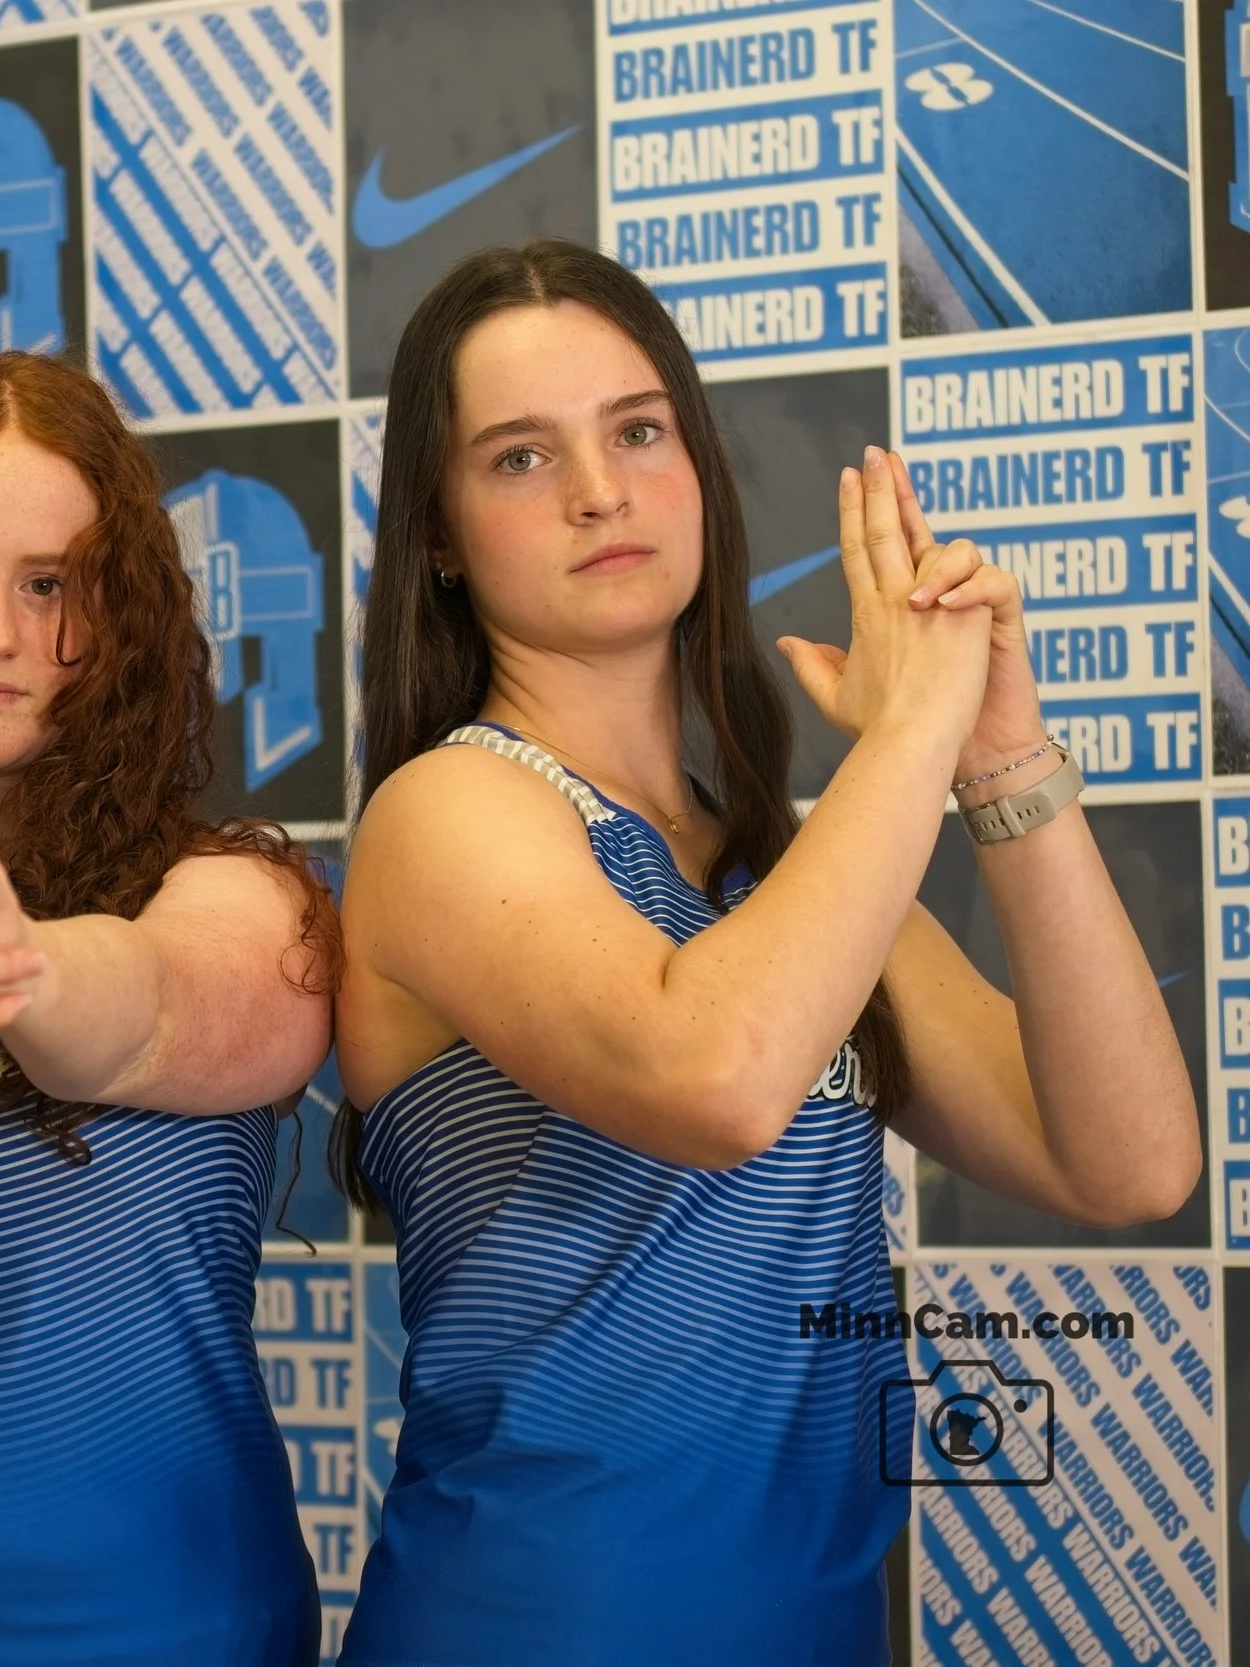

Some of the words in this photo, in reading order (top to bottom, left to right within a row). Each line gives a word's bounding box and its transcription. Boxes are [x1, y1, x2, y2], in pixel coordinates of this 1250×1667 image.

[614, 28, 816, 103] BRAINERD
[831, 19, 878, 75] TF
[613, 114, 820, 192] BRAINERD
[831, 106, 881, 167] TF
[617, 200, 820, 271] BRAINERD
[836, 192, 882, 249] TF
[672, 286, 824, 351] AINERD
[837, 279, 885, 338] TF
[905, 359, 1124, 434] BRAINERD
[1139, 353, 1190, 414] TF
[908, 445, 1125, 514] BRAINERD
[1141, 439, 1191, 497] TF
[1143, 531, 1194, 591] TF
[1145, 621, 1195, 678] TF
[1147, 711, 1198, 770] TF
[306, 1279, 352, 1334] TF
[310, 1358, 353, 1410] TF
[311, 1442, 357, 1496] TF
[1037, 1413, 1134, 1550] WARRIORS
[1090, 1401, 1188, 1542] WARRIORS
[314, 1524, 354, 1576] TF
[1062, 1522, 1161, 1664] WARRIORS
